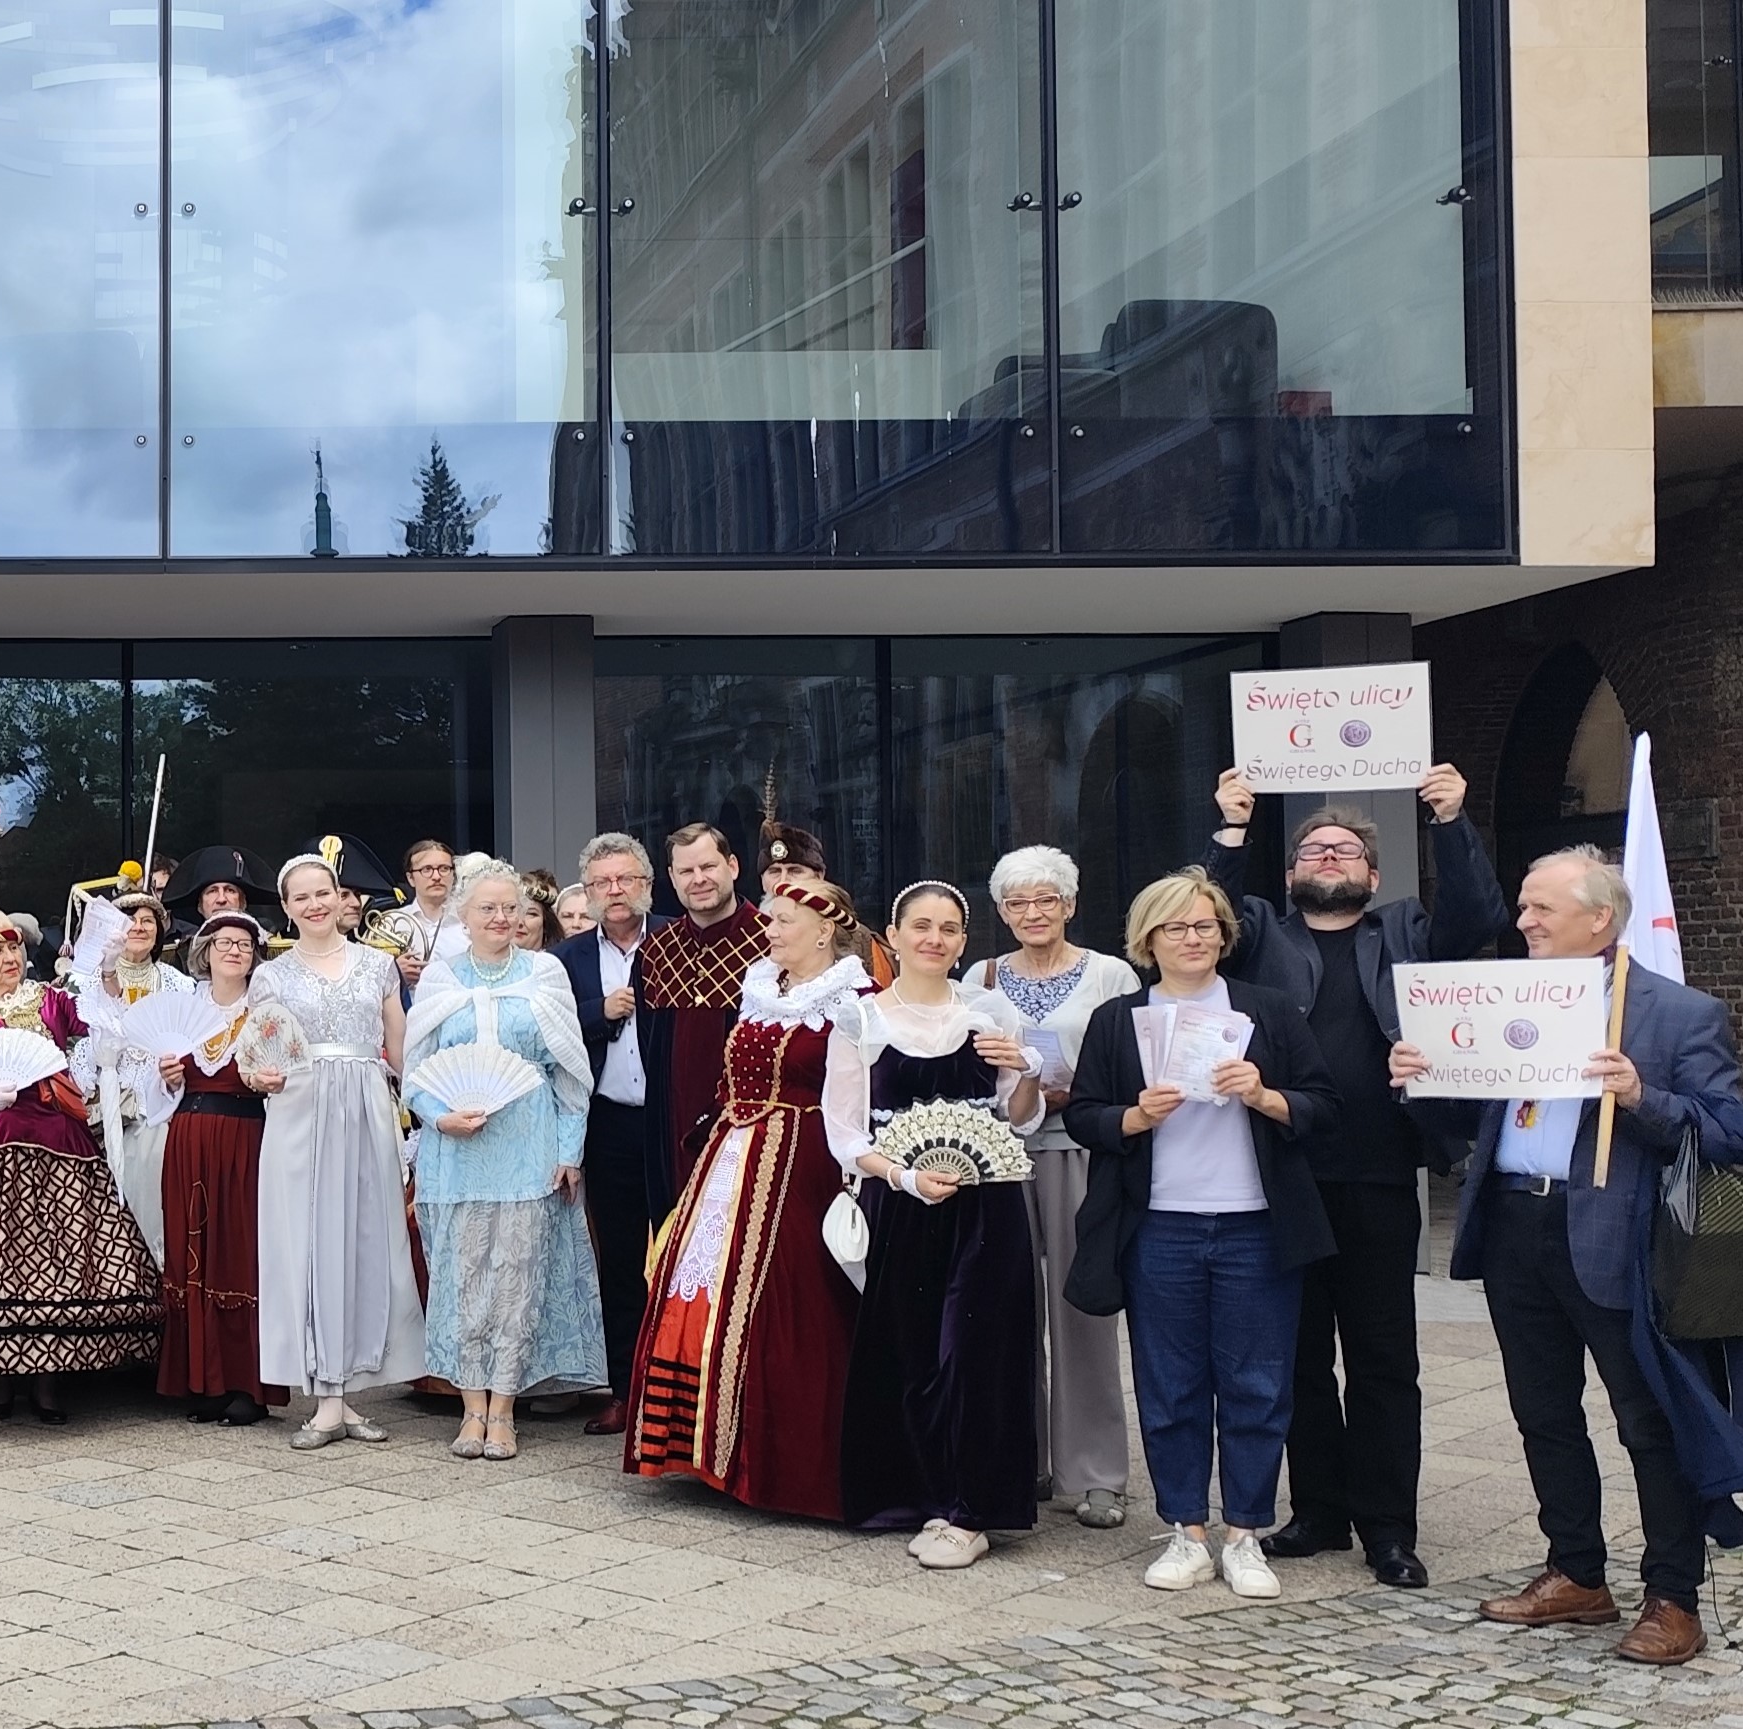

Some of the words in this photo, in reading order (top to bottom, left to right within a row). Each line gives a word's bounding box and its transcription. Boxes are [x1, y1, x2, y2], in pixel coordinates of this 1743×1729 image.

[1246, 680, 1340, 716] Święto
[1350, 684, 1413, 710] ulicy
[1245, 755, 1347, 784] Świętego
[1352, 757, 1422, 776] Ducha
[1408, 973, 1503, 1013] Święto
[1515, 980, 1586, 1009] ulicy
